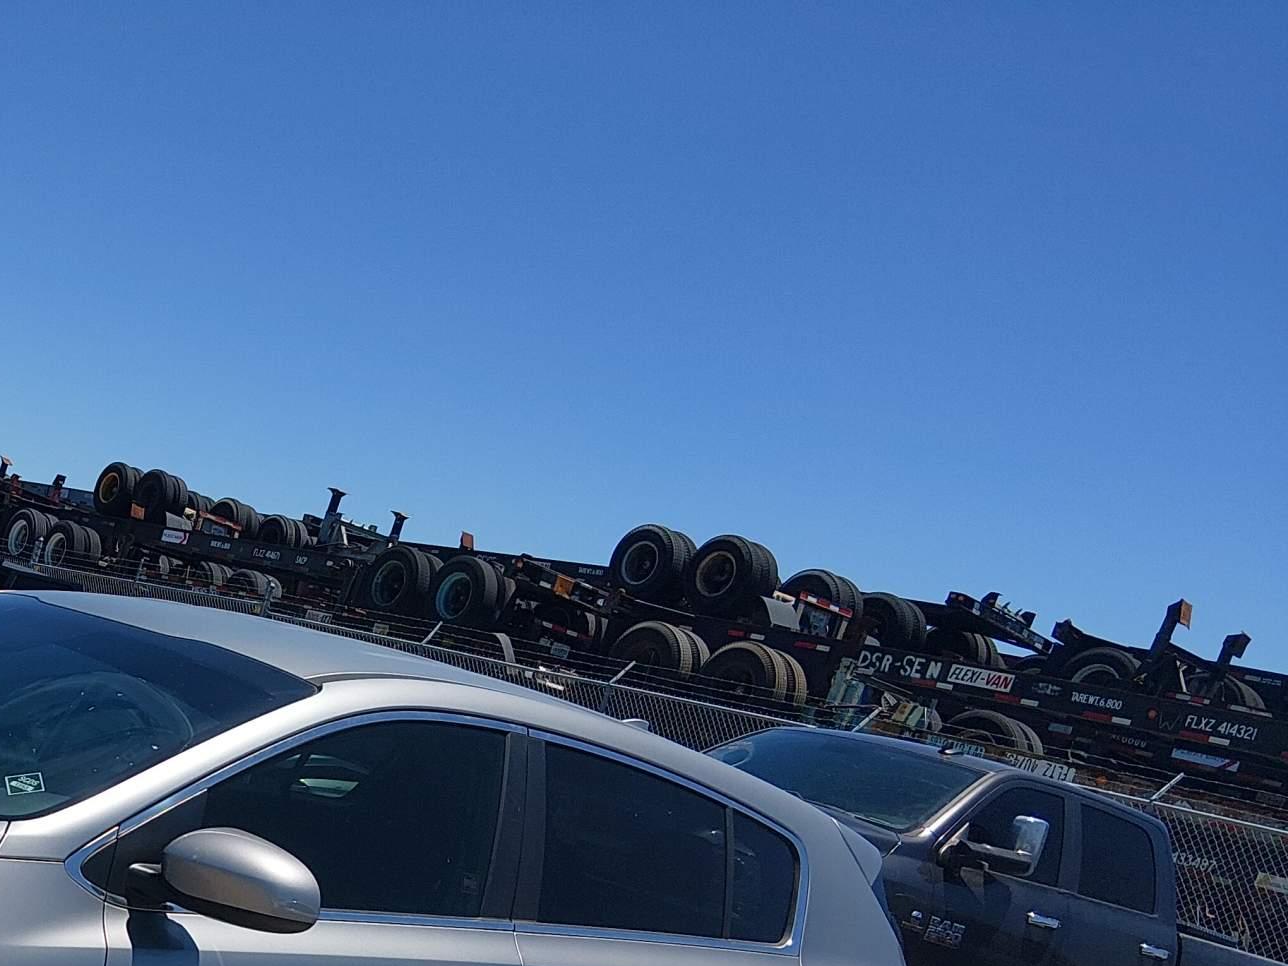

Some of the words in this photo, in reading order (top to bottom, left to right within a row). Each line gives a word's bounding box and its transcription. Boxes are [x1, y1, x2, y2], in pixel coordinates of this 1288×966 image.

[949, 667, 1013, 690] FLEXI-VAN
[1185, 714, 1216, 732] FLXZ
[1217, 721, 1258, 741] 414321
